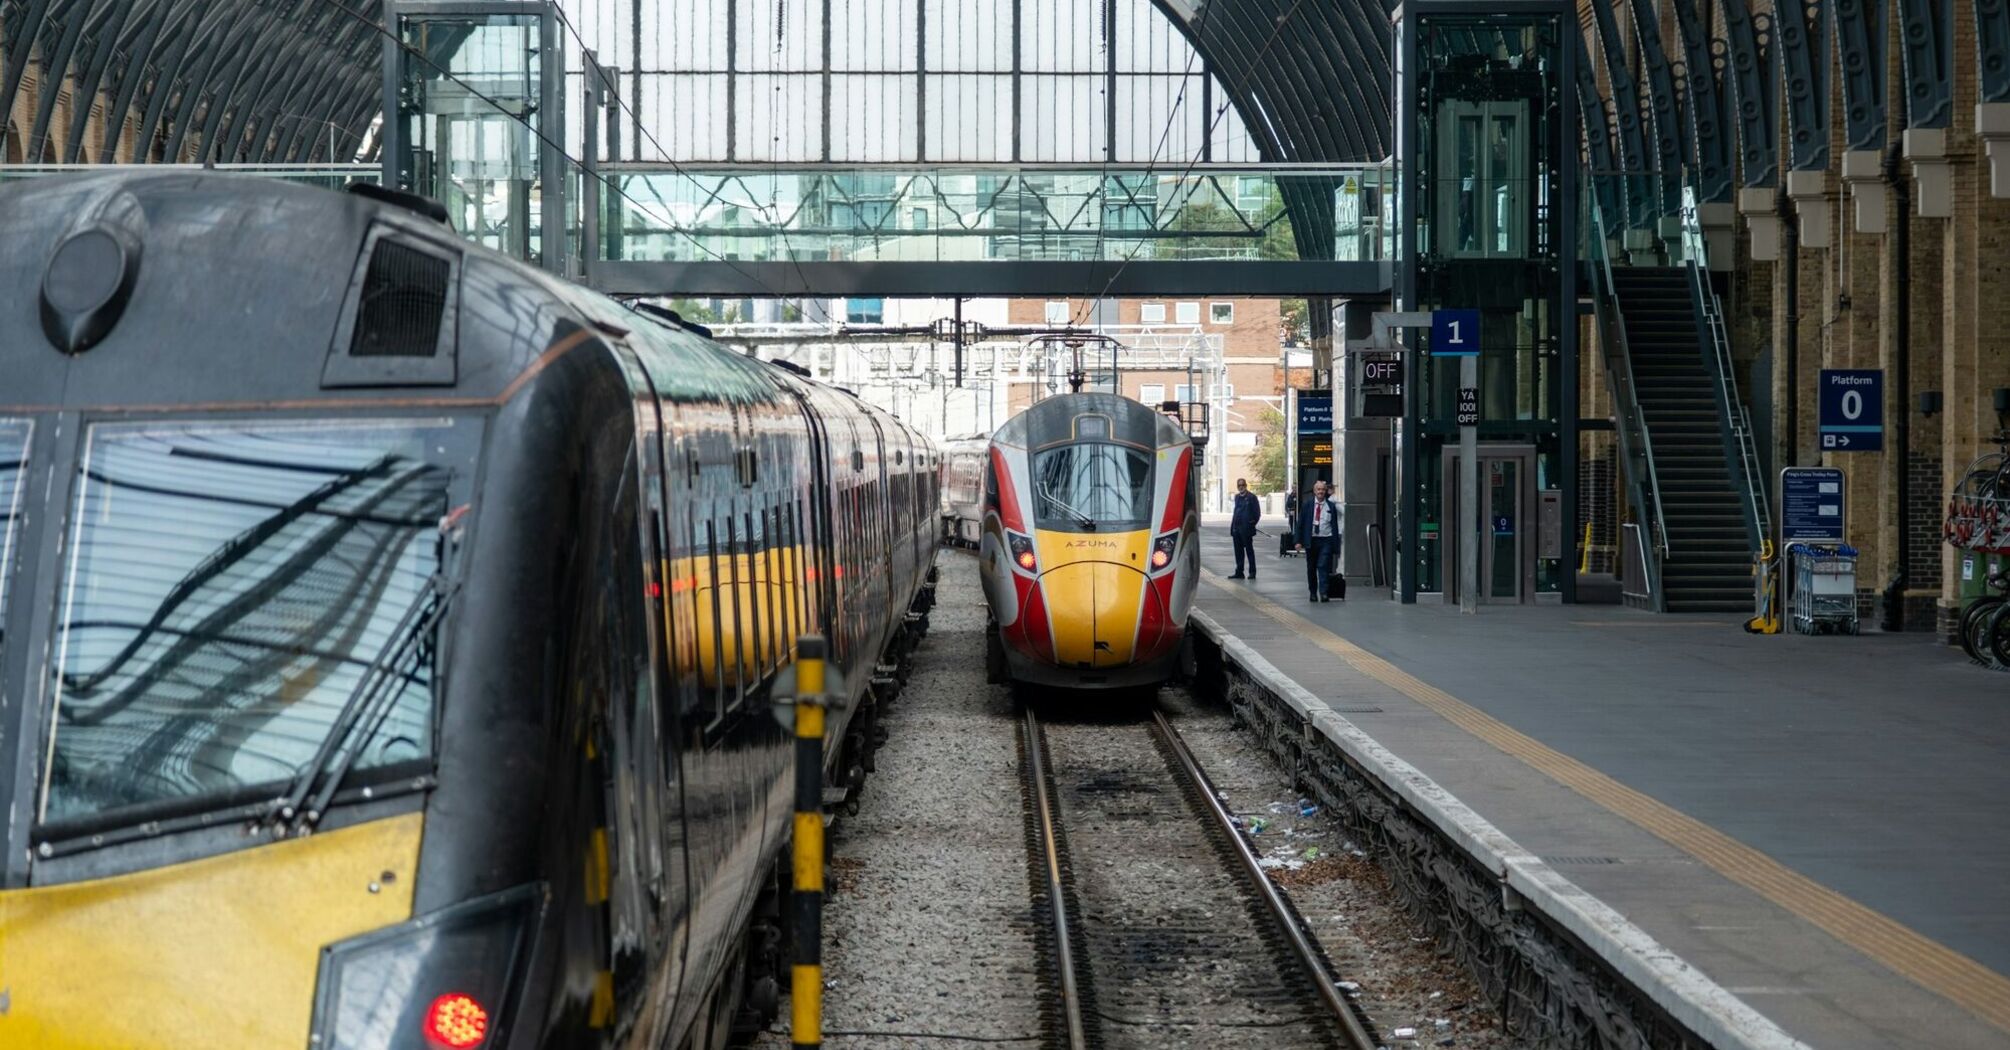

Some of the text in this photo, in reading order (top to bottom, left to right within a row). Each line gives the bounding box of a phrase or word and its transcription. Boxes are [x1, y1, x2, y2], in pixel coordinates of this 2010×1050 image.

[1448, 320, 1464, 344] 1
[1366, 363, 1397, 378] OFF
[1831, 375, 1873, 385] Platform
[1461, 391, 1475, 400] YA
[1841, 389, 1863, 420] 0
[1457, 414, 1478, 423] OFF
[1065, 540, 1118, 549] AZUMA
